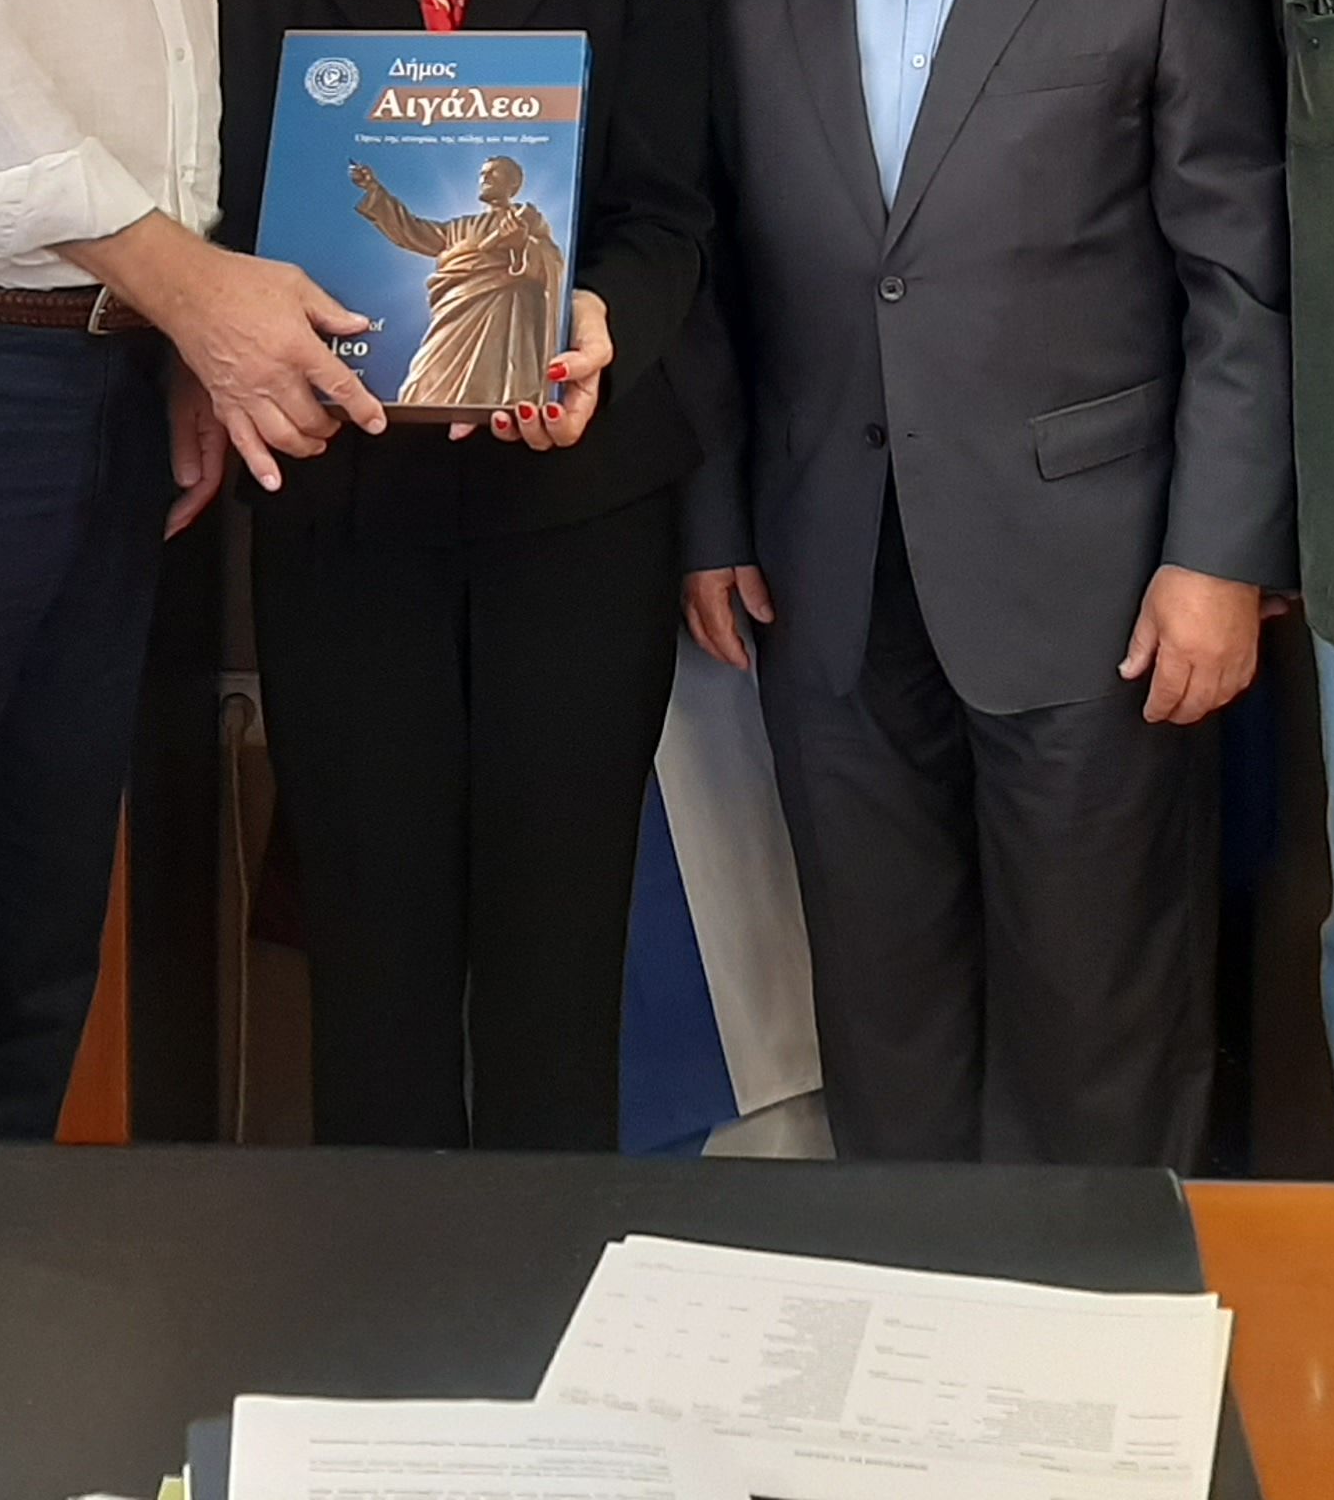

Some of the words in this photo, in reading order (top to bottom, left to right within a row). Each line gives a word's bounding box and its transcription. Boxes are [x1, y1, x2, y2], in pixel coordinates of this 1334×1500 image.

[388, 57, 458, 82] Δήμος
[372, 87, 540, 126] Αιγάλεω
[368, 317, 386, 332] of
